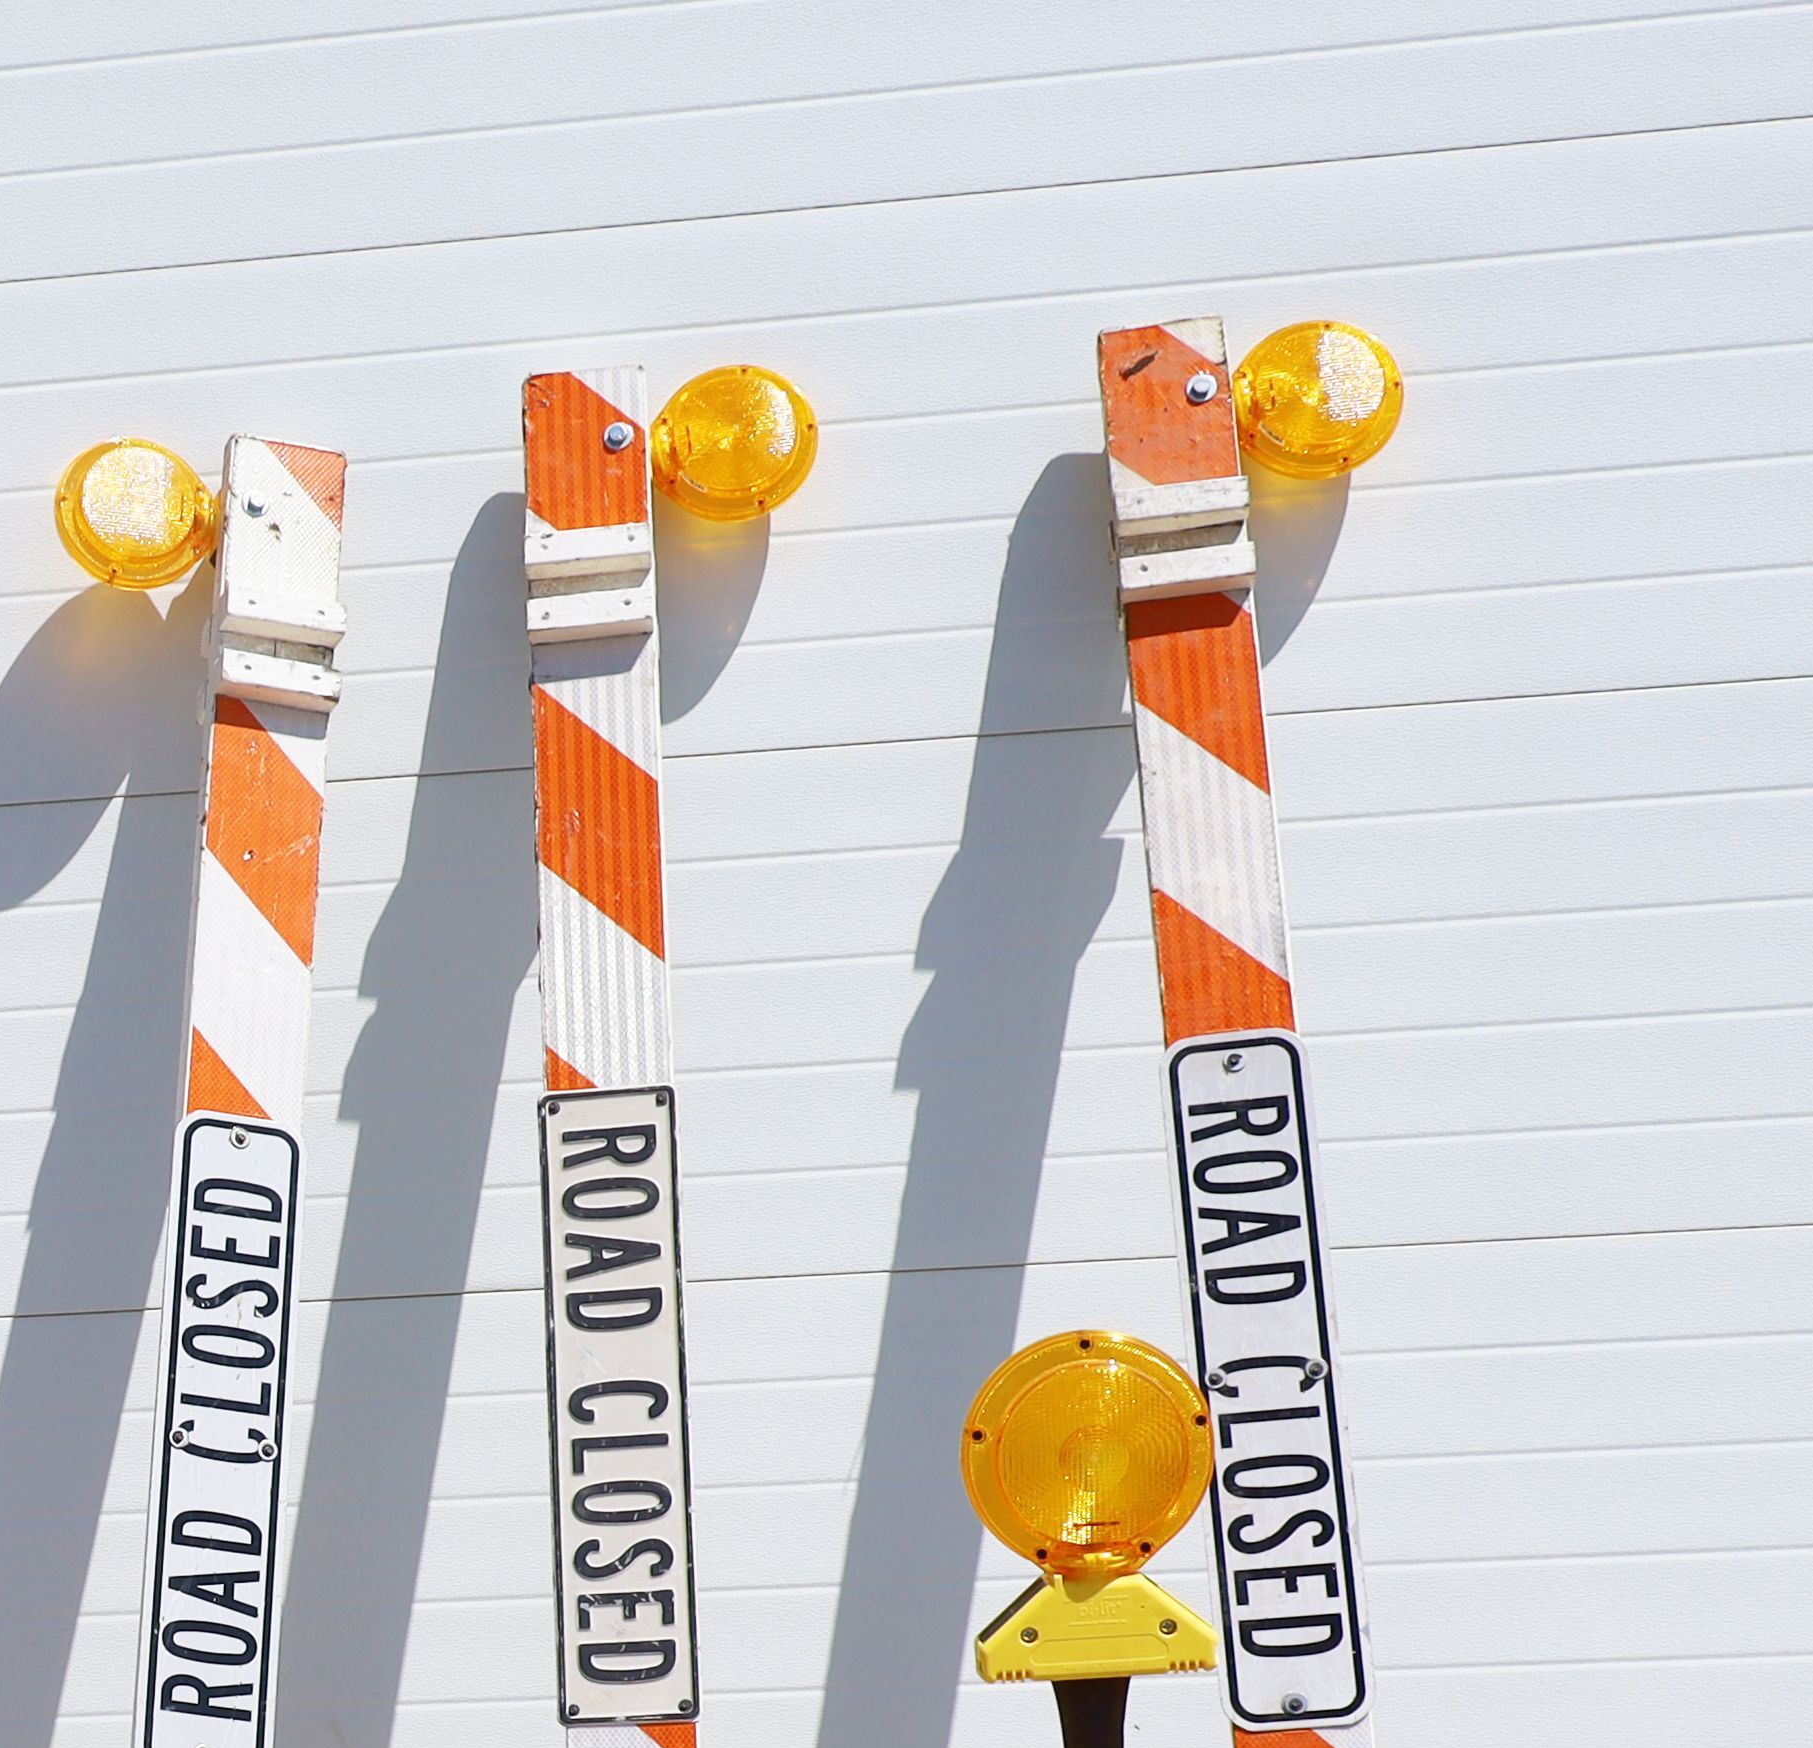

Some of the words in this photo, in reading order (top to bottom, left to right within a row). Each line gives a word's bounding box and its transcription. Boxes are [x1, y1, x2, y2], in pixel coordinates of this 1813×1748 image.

[173, 1178, 283, 1464] CLOSED
[561, 1124, 663, 1332] ROAD
[1188, 1095, 1306, 1304] ROAD
[159, 1511, 272, 1722] ROAD
[569, 1379, 677, 1684] CLOSED
[1206, 1354, 1344, 1657] CLOSED
